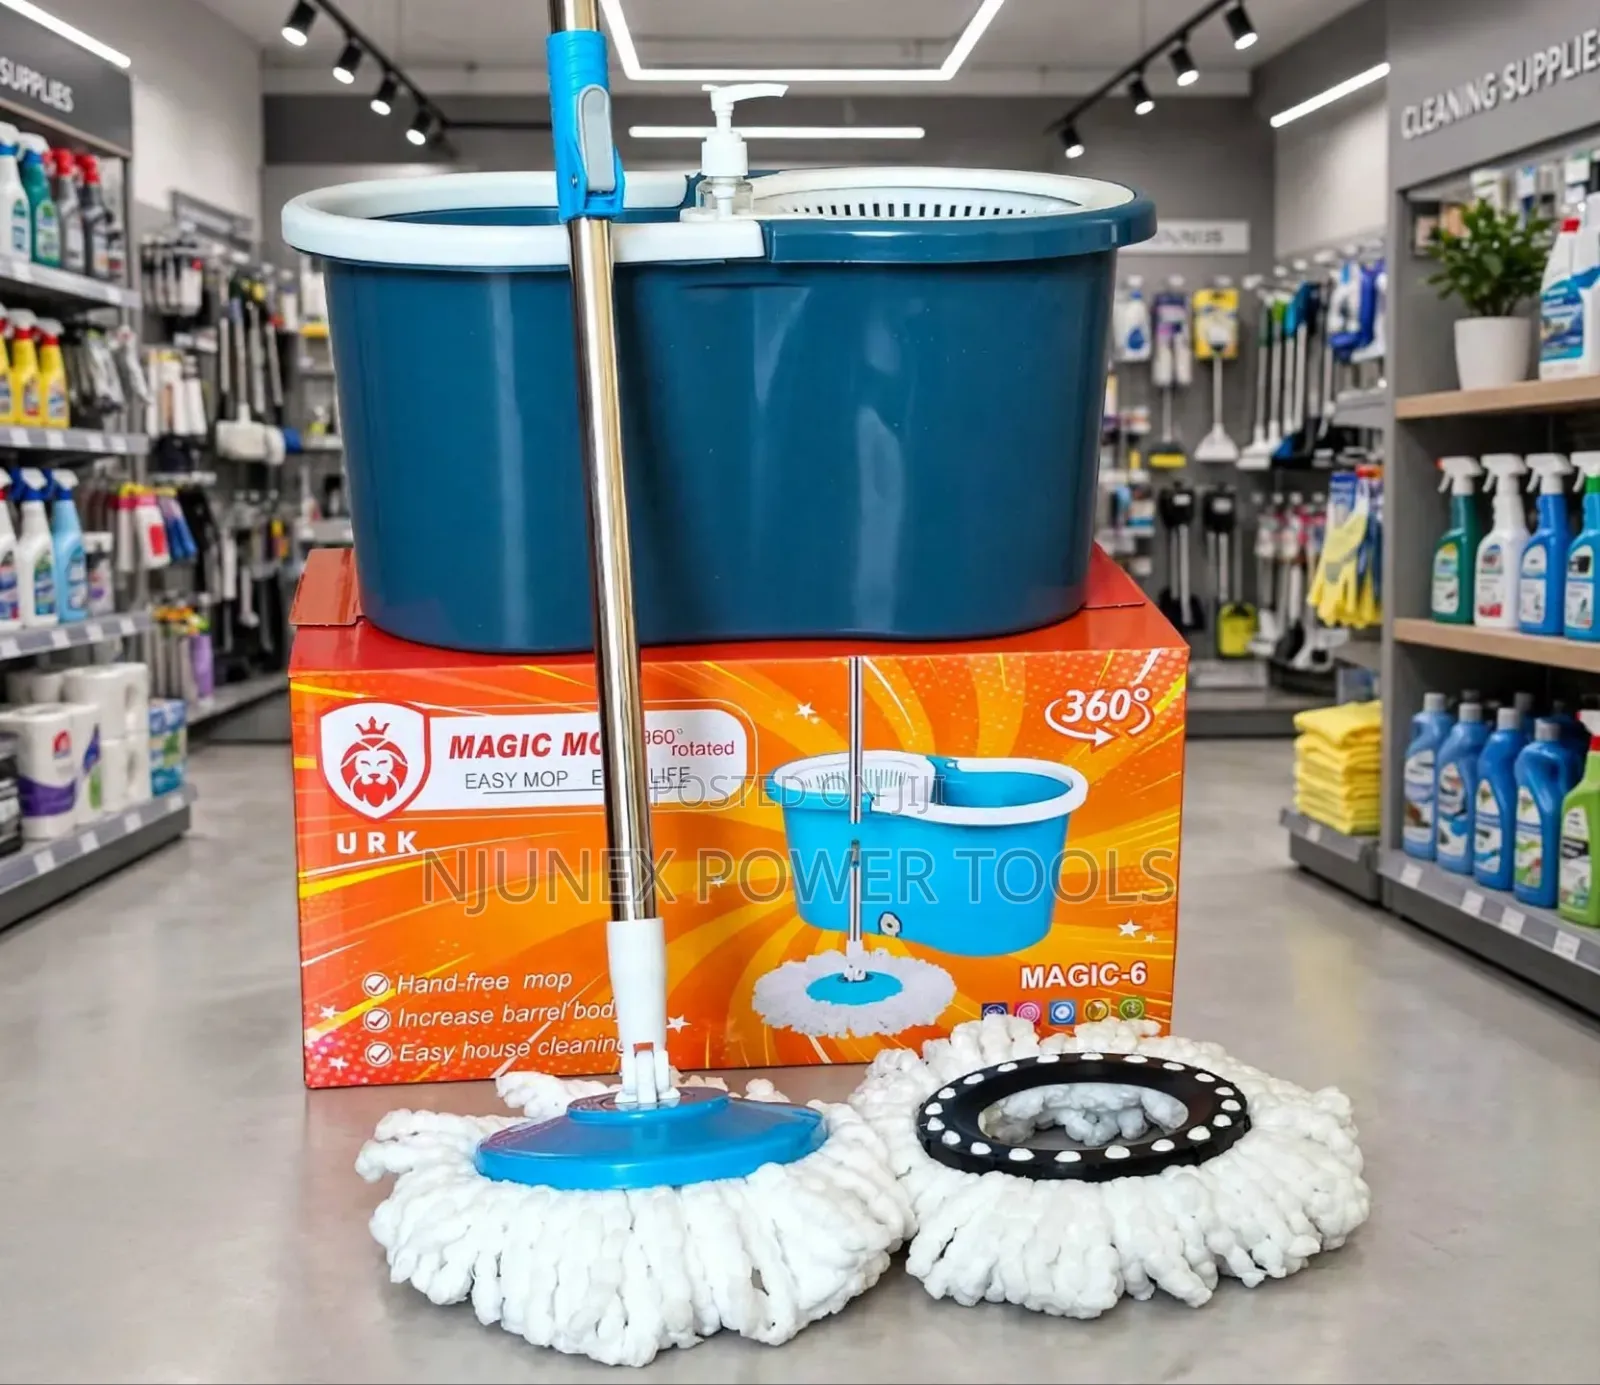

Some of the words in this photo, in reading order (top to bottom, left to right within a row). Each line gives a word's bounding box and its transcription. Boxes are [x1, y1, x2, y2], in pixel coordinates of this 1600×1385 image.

[1502, 28, 1600, 101] SUPPLIE
[449, 732, 552, 760] MAGIC
[671, 740, 735, 757] rotated
[465, 772, 518, 789] EASY
[523, 770, 569, 788] MOP
[650, 766, 691, 784] LIFE
[336, 830, 421, 855] URK
[397, 972, 509, 996] Hand-free
[523, 972, 573, 992] mop
[1021, 961, 1148, 990] MAGIC-6
[398, 1007, 493, 1028] Increase
[502, 1003, 567, 1024] barrel
[573, 1000, 618, 1022] bod
[398, 1043, 456, 1066] Easy
[462, 1040, 531, 1060] house
